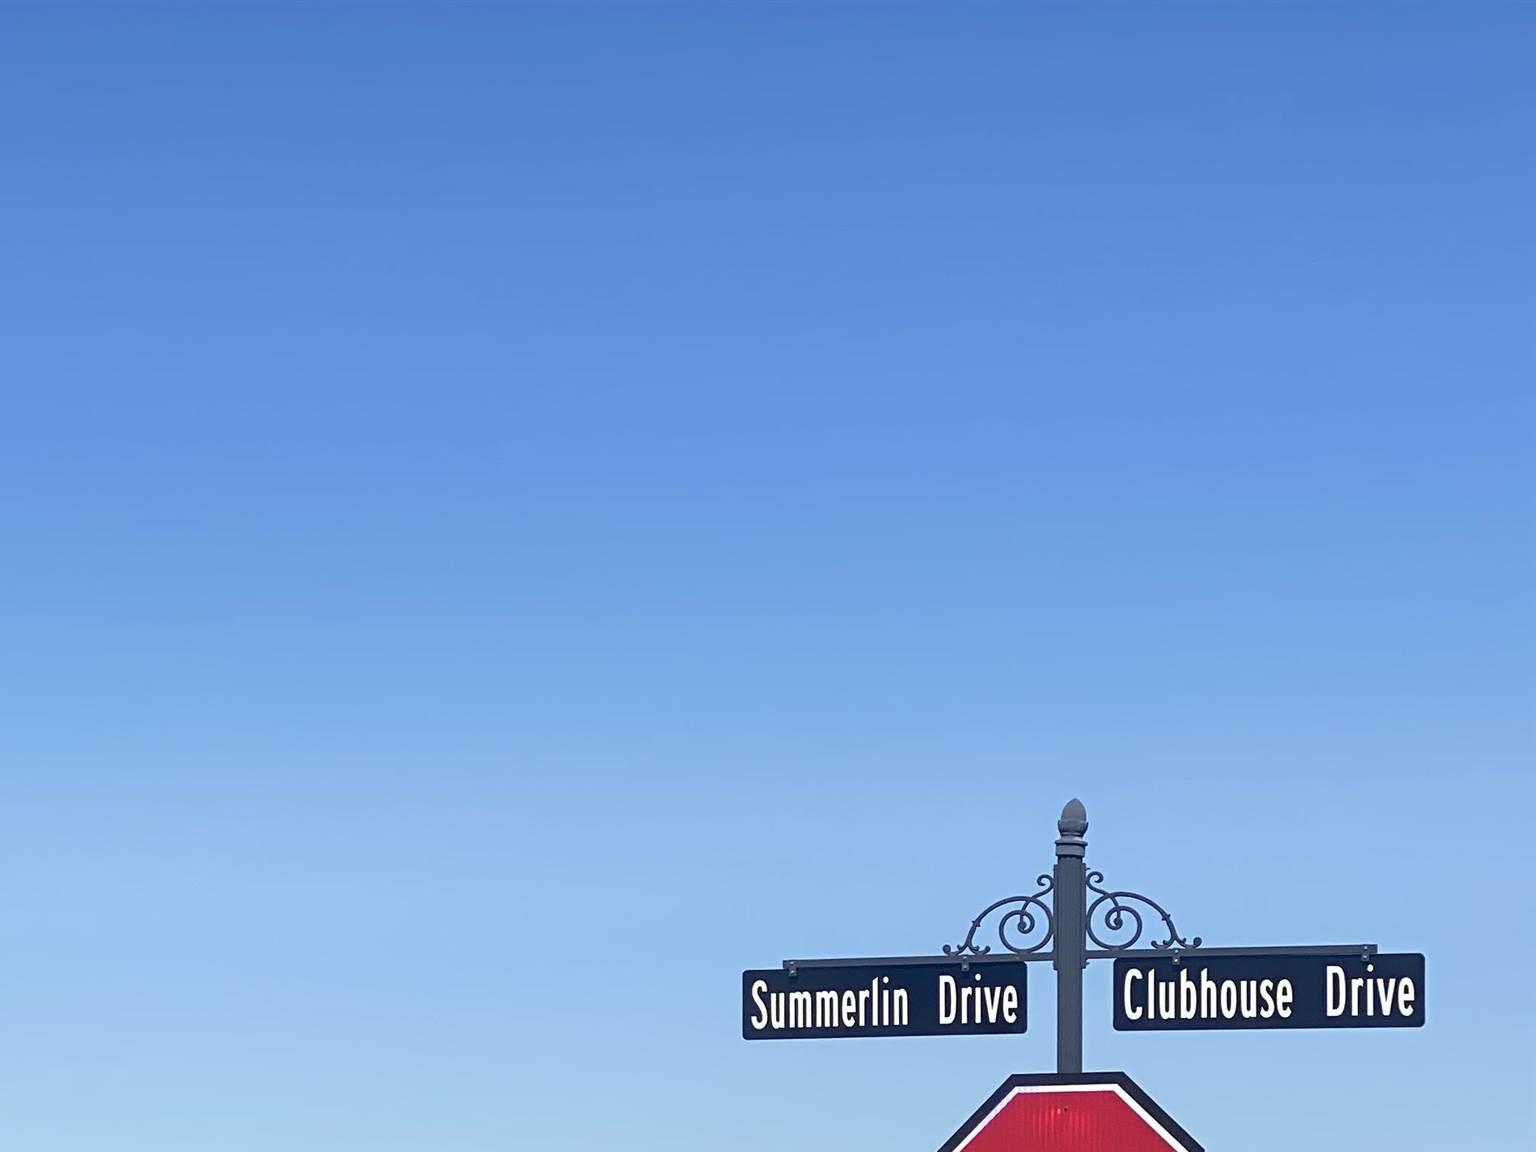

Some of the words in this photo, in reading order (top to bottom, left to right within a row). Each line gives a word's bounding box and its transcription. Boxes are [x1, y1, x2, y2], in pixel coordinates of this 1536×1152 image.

[750, 976, 908, 1030] Summerlin
[938, 974, 1018, 1025] Drive
[1123, 966, 1293, 1020] Clubhouse
[1325, 964, 1415, 1017] Drive
